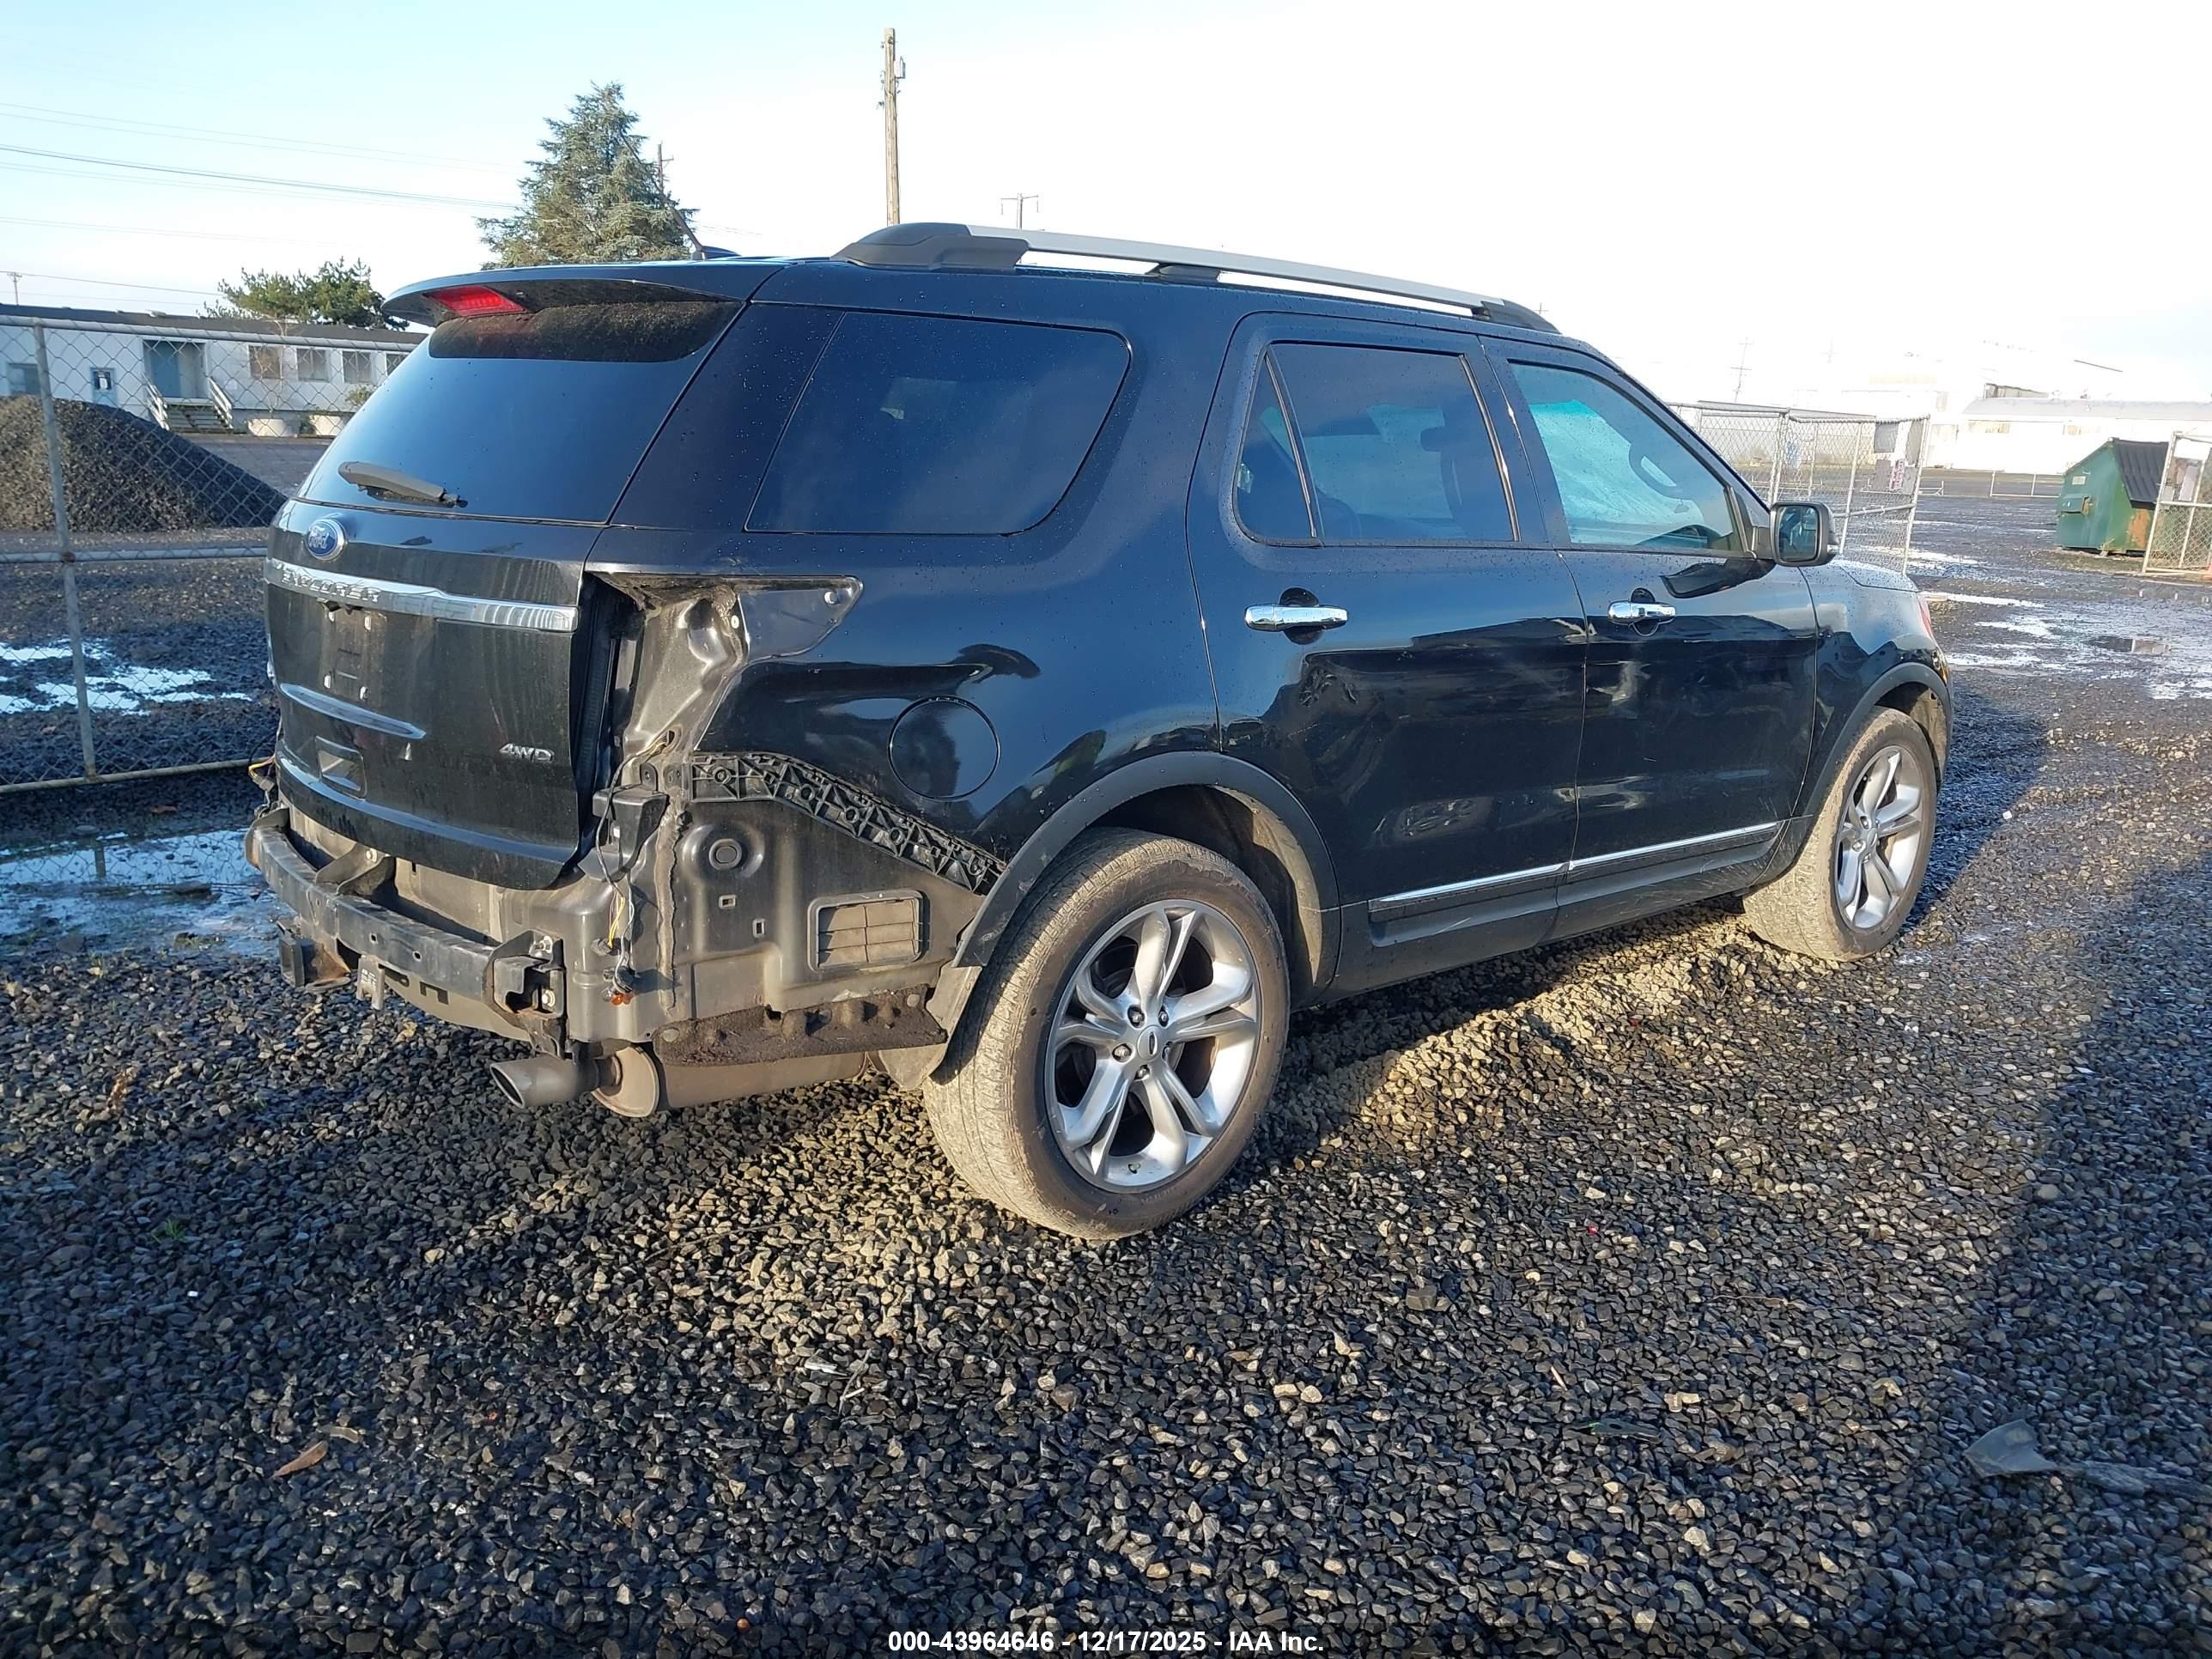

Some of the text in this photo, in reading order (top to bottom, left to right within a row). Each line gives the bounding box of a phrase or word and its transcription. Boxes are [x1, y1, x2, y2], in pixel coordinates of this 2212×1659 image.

[308, 525, 330, 550] Ford
[281, 567, 382, 603] EXPLORER
[499, 743, 554, 763] 4WD
